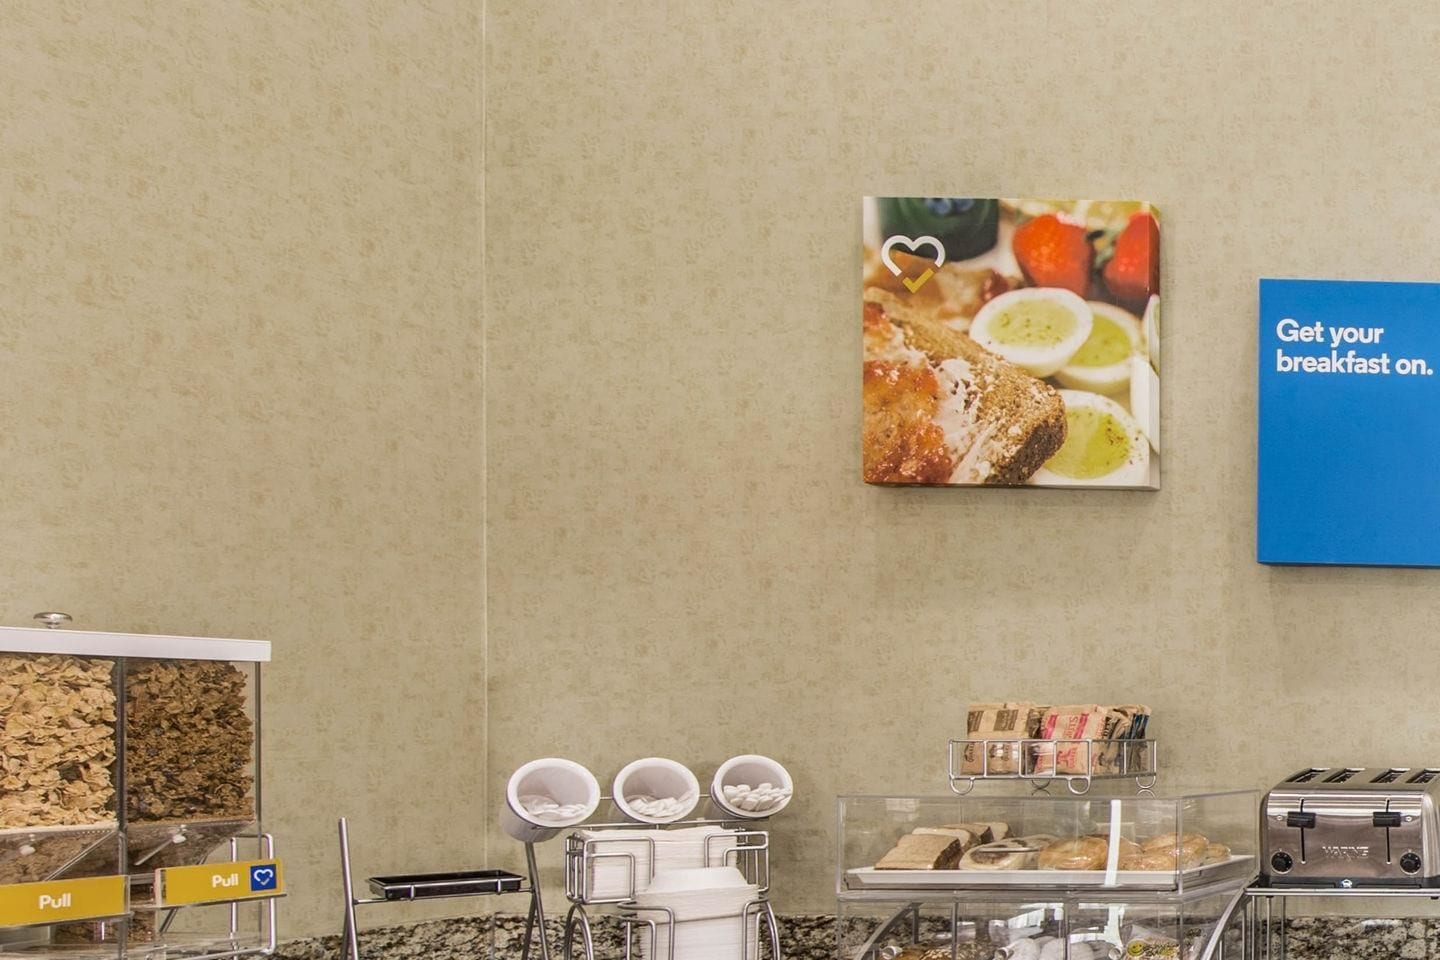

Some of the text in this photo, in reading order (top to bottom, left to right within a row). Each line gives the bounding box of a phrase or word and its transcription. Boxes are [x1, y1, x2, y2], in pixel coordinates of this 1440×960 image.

[1276, 318, 1385, 348] Get your
[1276, 348, 1434, 376] breakfast on.
[211, 874, 239, 888] Pull
[38, 893, 72, 910] Pull
